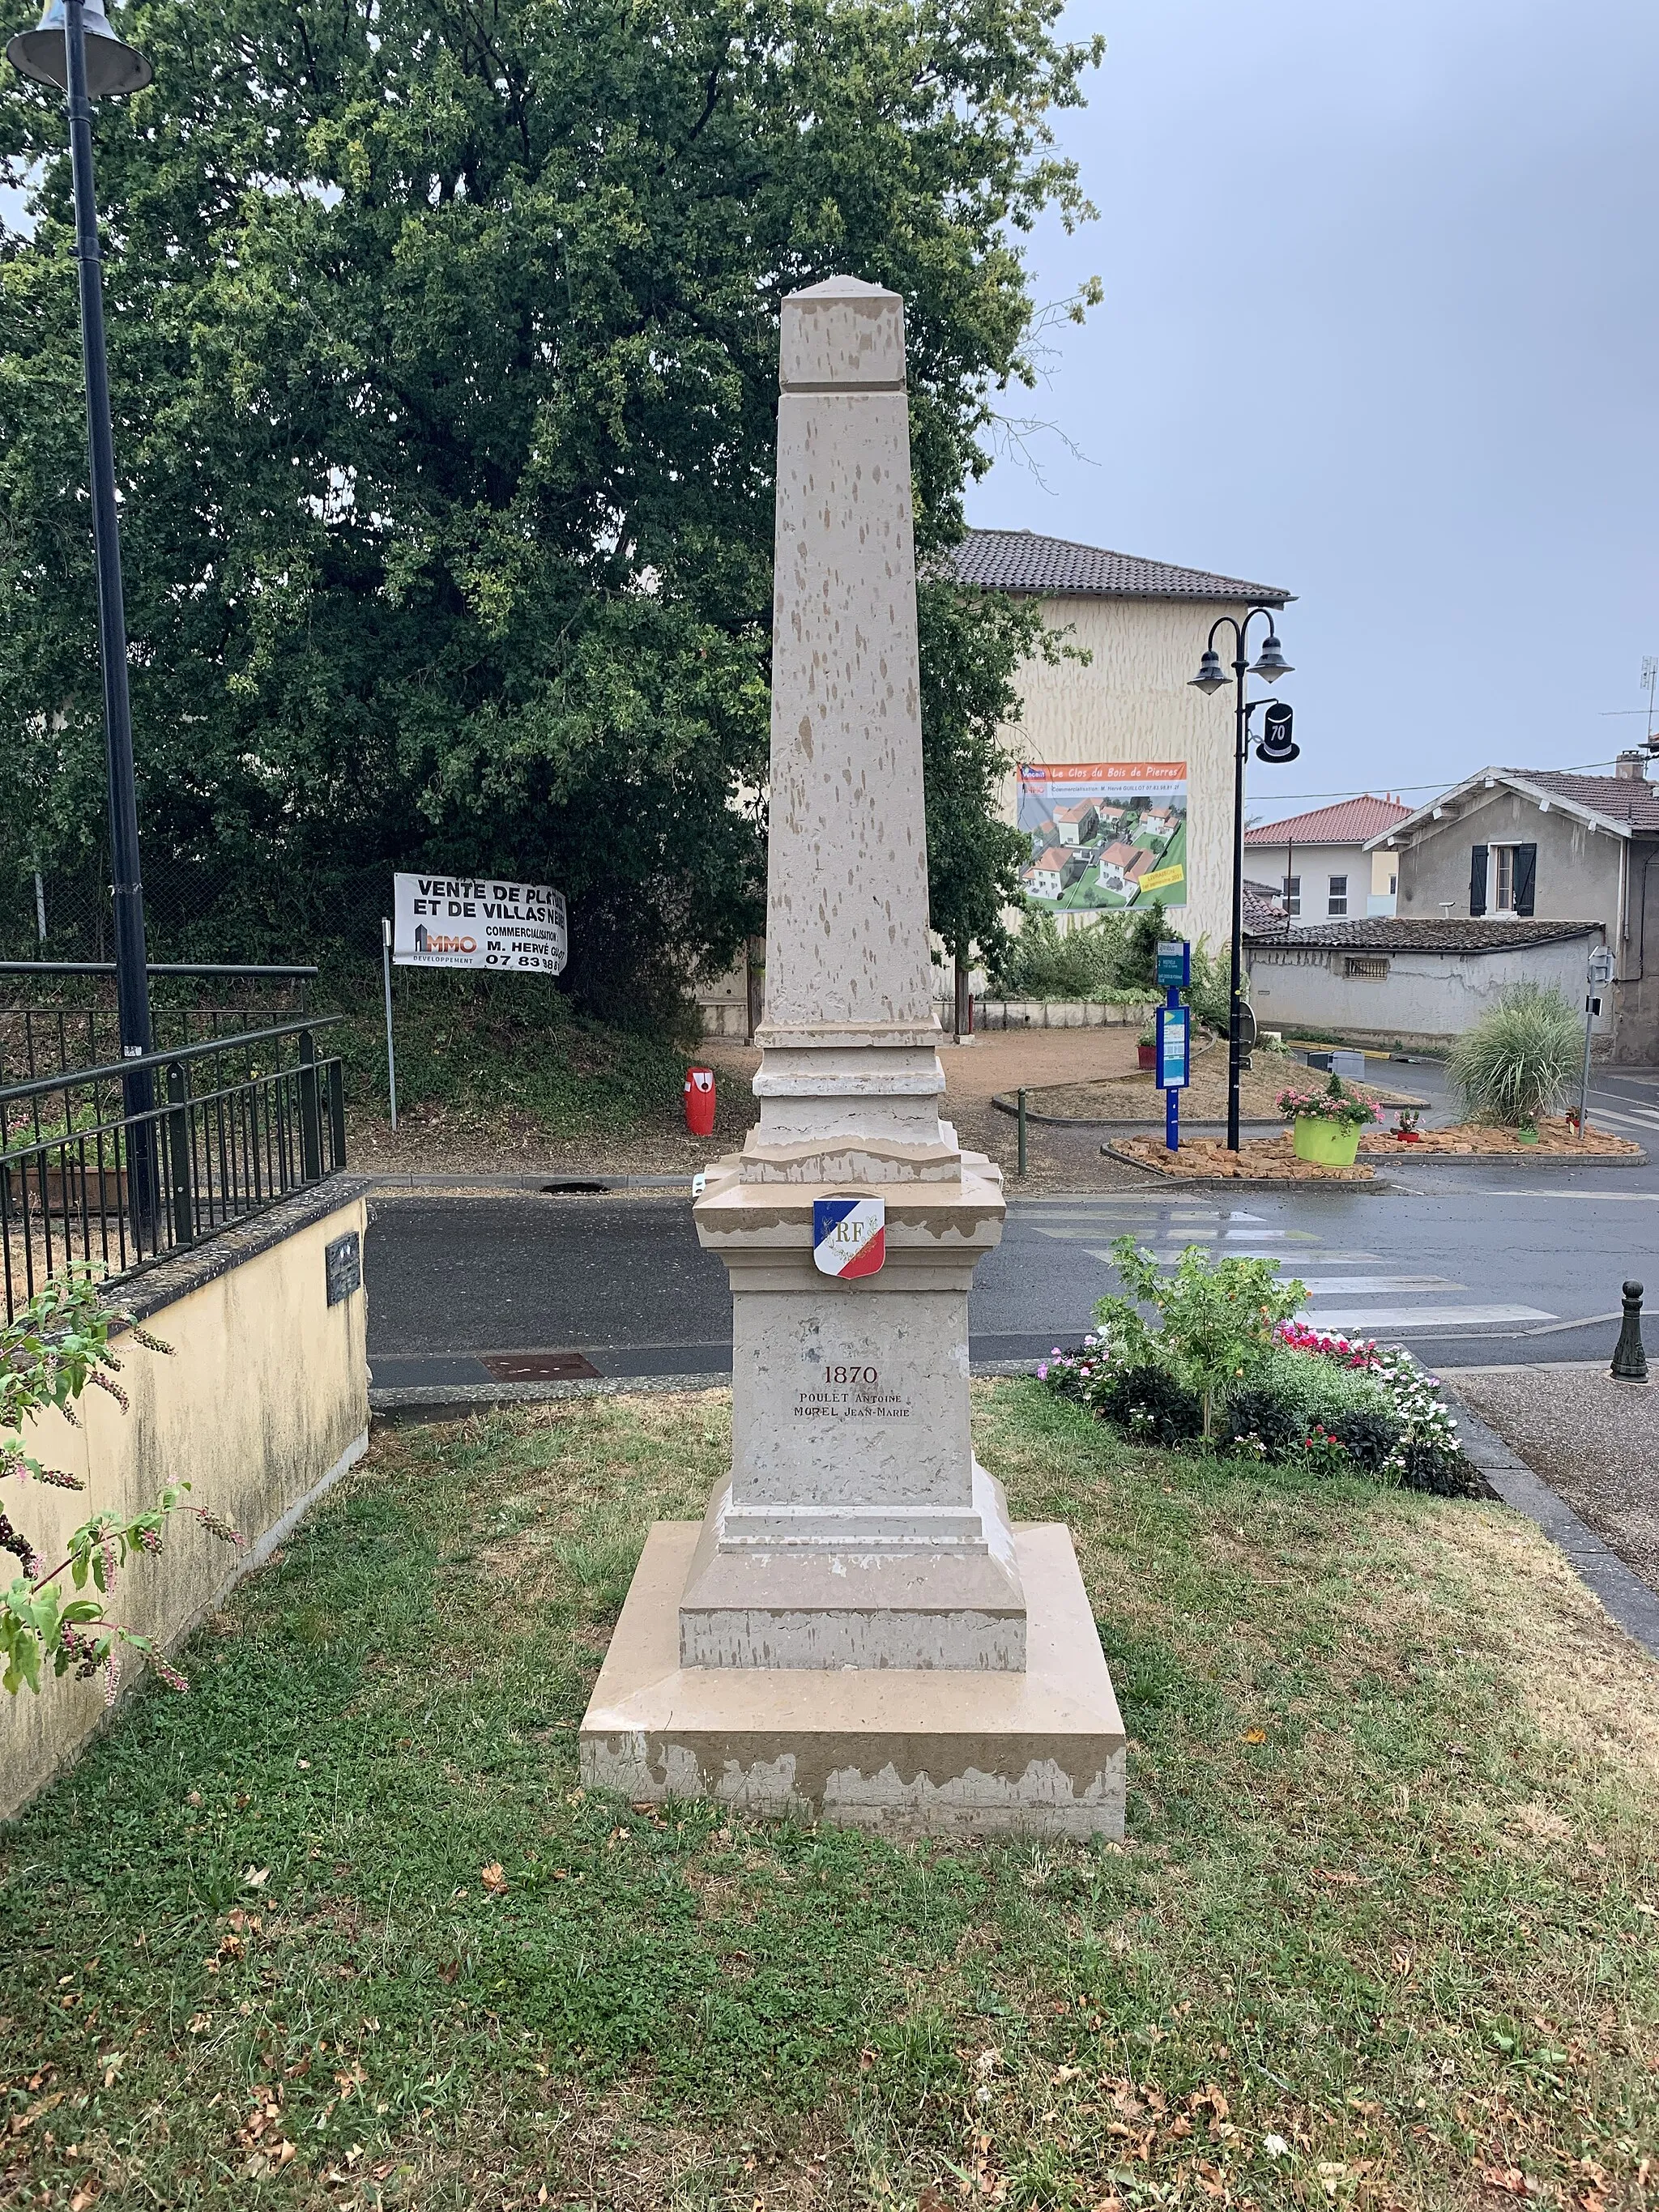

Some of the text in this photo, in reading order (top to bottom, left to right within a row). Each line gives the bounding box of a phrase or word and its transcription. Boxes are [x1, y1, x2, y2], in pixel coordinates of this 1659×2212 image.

[1271, 725, 1285, 741] 70
[1052, 766, 1178, 778] Le Clos du Bois de Pierres
[418, 880, 486, 899] VENTE
[493, 885, 520, 901] DE
[414, 899, 441, 915] ET
[449, 901, 476, 918] DE
[483, 903, 545, 922] VILLAS
[487, 940, 505, 951] M.
[512, 942, 548, 956] HERVÉ
[414, 956, 473, 964] DEVELOPPEMENT
[486, 955, 511, 965] 07
[518, 956, 540, 967] 83
[542, 958, 553, 970] 98
[835, 1222, 864, 1242] RF
[825, 1366, 877, 1383] 1870
[800, 1393, 849, 1404] POULET
[794, 1407, 838, 1417] MOREL
